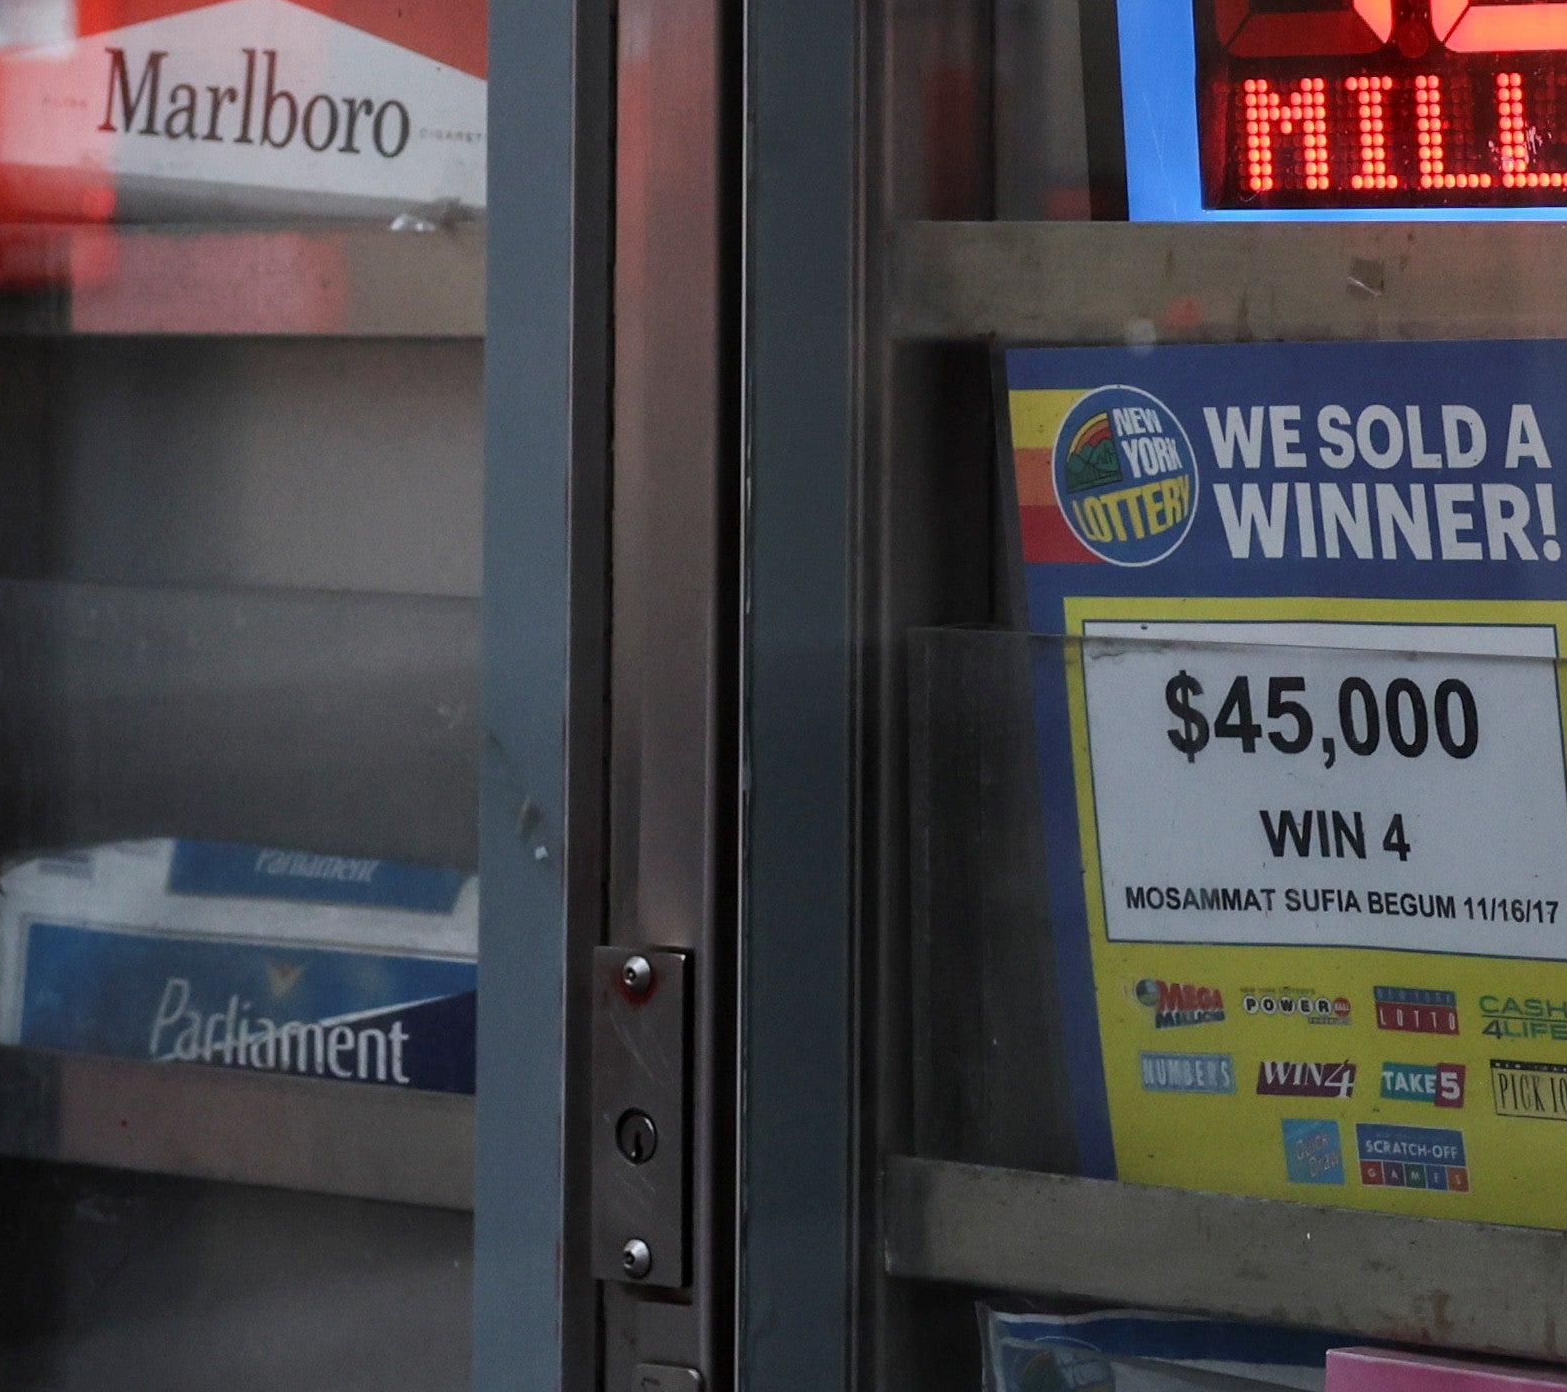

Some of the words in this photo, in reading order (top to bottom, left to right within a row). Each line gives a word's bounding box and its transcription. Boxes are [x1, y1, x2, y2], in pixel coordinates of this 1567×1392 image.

[96, 47, 410, 160] Marlboro
[1112, 407, 1161, 438] NEW
[1203, 404, 1305, 469] WE
[1318, 403, 1487, 470] SOLD
[1504, 403, 1552, 468] A
[1122, 436, 1180, 478] YORK
[1071, 479, 1191, 544] LOTTERY
[1212, 482, 1561, 562] WINNER!
[1165, 670, 1480, 770] $45,000
[1260, 810, 1367, 860] WIN
[1382, 813, 1412, 862] 4
[1125, 886, 1276, 912] MOSAMMAT
[1284, 888, 1362, 914] SUFIA
[1367, 892, 1457, 920] BEGUM
[1464, 897, 1559, 925] 11/16/17
[149, 977, 411, 1085] Parliament
[1498, 1073, 1545, 1113] PICK
[1366, 1139, 1459, 1160] SCRATCH-OFF
